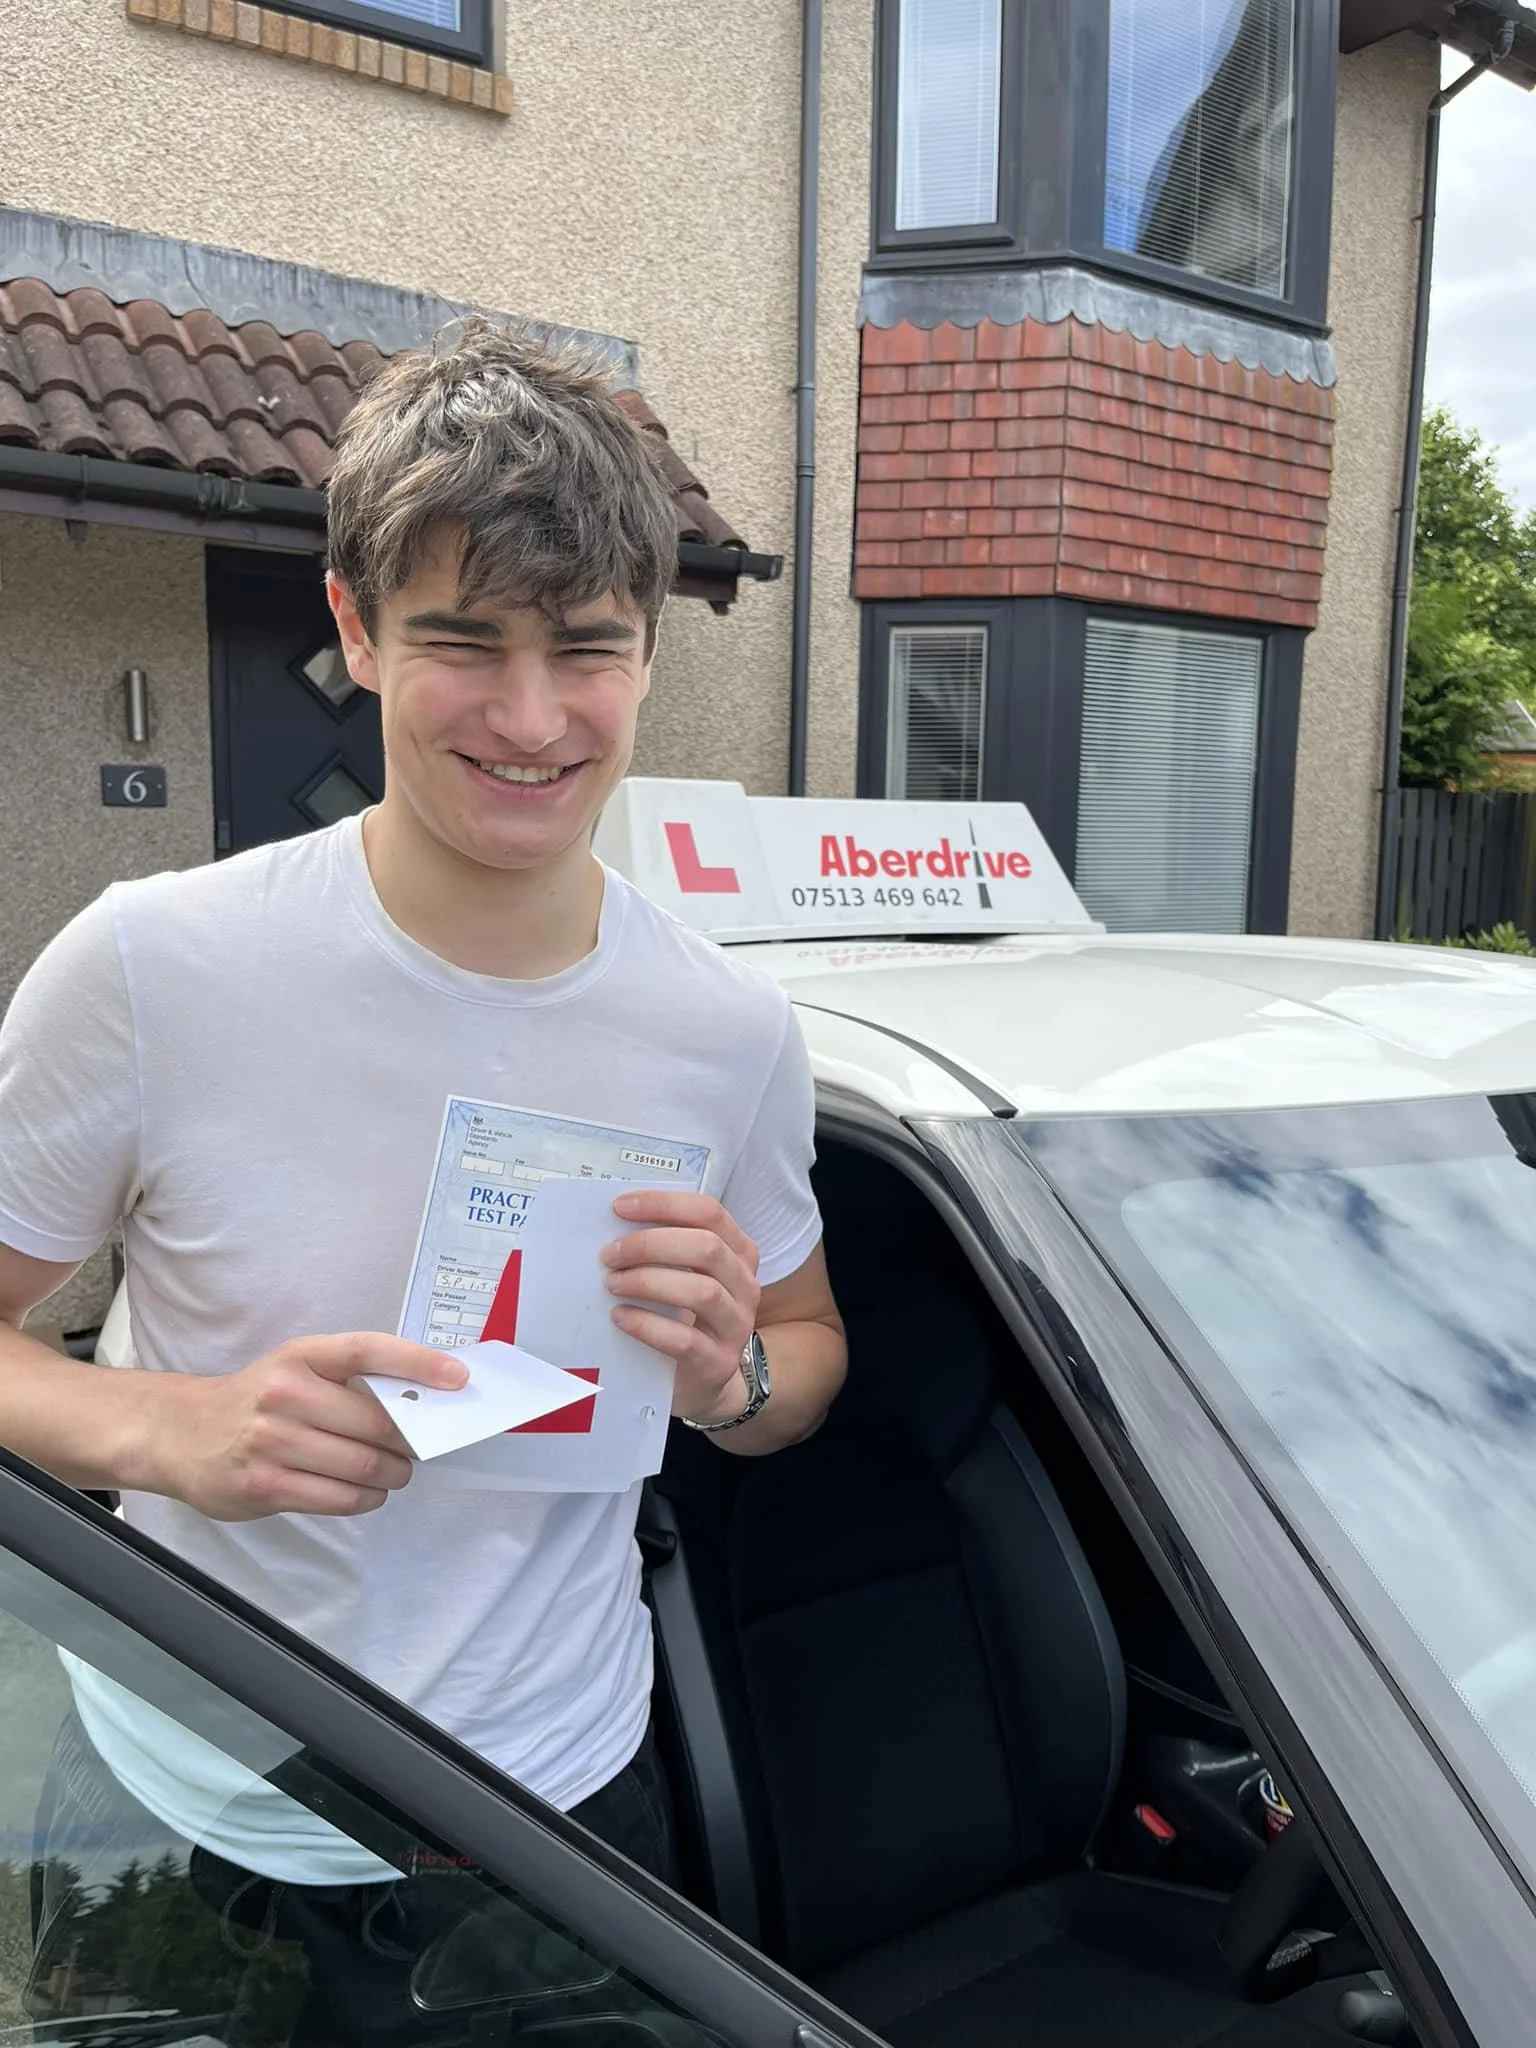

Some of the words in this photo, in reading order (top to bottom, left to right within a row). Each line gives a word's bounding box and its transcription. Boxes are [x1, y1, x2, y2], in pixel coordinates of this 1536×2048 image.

[123, 770, 148, 803] 6
[664, 822, 741, 893] L
[820, 834, 1033, 880] Aberdrive
[791, 887, 866, 907] 07513
[873, 887, 915, 907] 469
[922, 888, 963, 907] 642
[468, 1205, 506, 1225] TEST
[439, 1254, 458, 1263] Name
[433, 1301, 461, 1312] Category
